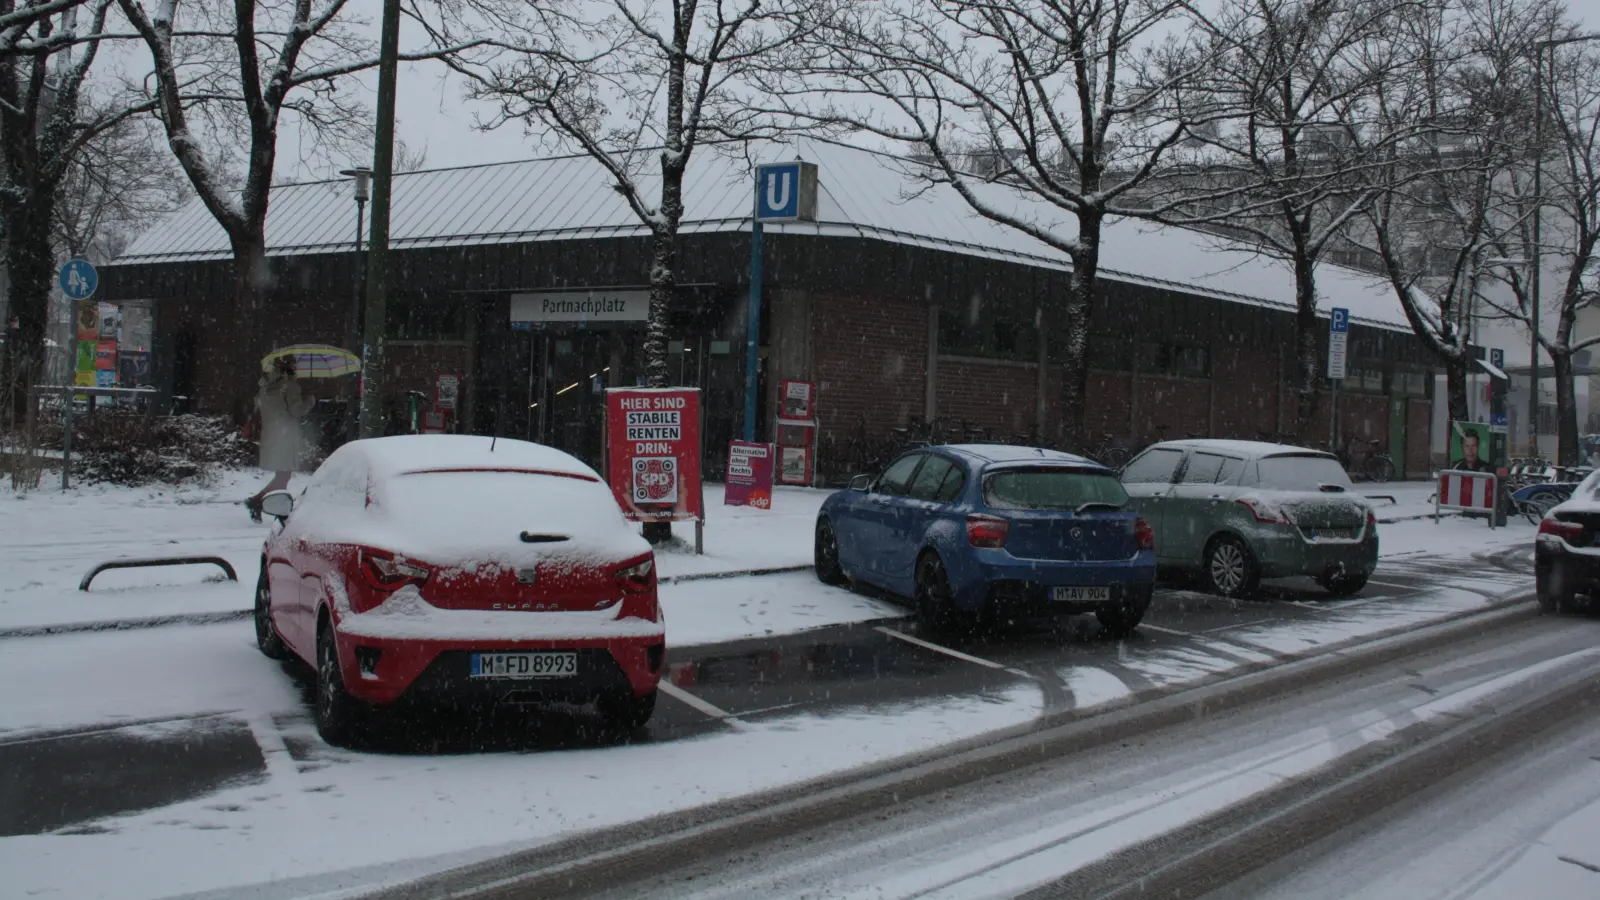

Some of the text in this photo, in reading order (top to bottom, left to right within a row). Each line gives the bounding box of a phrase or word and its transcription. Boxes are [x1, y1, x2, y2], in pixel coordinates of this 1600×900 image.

[767, 172, 790, 211] U
[542, 297, 625, 316] Partnachplatz
[1333, 310, 1344, 330] P
[620, 397, 686, 410] HIER SIND
[629, 412, 678, 424] STABILE
[629, 427, 679, 439] RENTEN
[636, 442, 672, 454] DRIN:
[732, 447, 766, 457] Alternative
[731, 457, 747, 465] ohne
[730, 467, 752, 475] Rechts
[641, 473, 669, 486] SPD
[750, 496, 769, 508] ödp
[1056, 587, 1106, 599] M AV 904
[481, 655, 575, 674] M FD 8993
